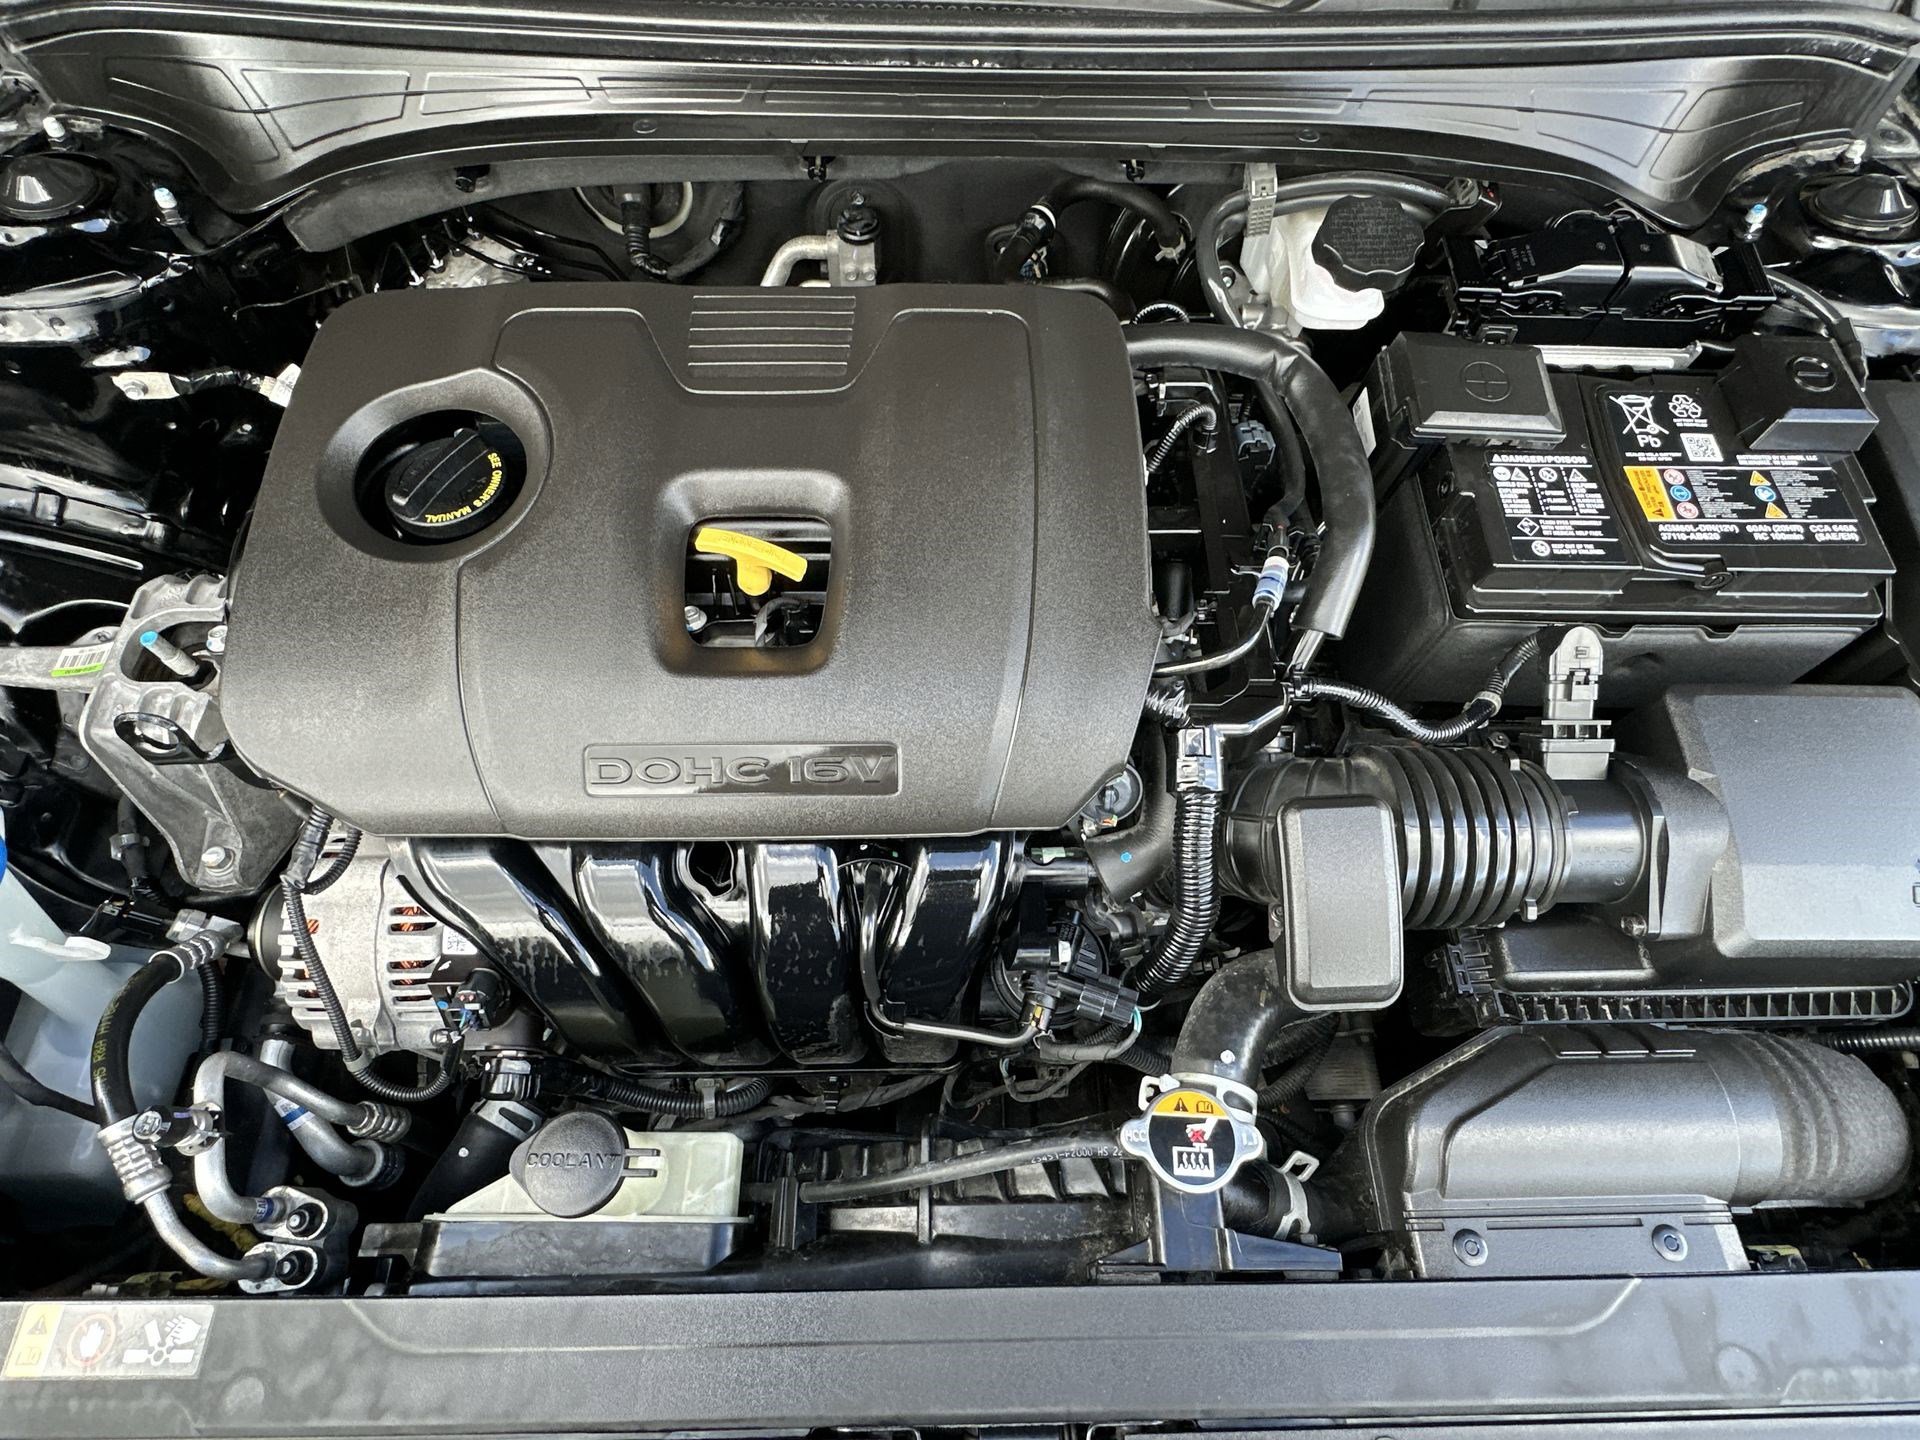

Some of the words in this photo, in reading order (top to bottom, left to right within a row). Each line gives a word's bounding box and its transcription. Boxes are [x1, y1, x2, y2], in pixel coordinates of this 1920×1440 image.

[1637, 435, 1661, 447] Pb
[488, 452, 502, 468] SEE
[1500, 455, 1588, 464] DANGER/POISON
[473, 470, 502, 508] OWNER'S
[425, 506, 472, 522] MANUAL
[1746, 524, 1771, 533] 60Ah
[1809, 525, 1831, 533] CCA
[1753, 532, 1770, 541] RC
[590, 756, 770, 785] DOHC
[787, 754, 896, 784] 16V
[1125, 1130, 1147, 1143] HCC
[1098, 1146, 1108, 1157] HS
[526, 1152, 622, 1168] COOLANT
